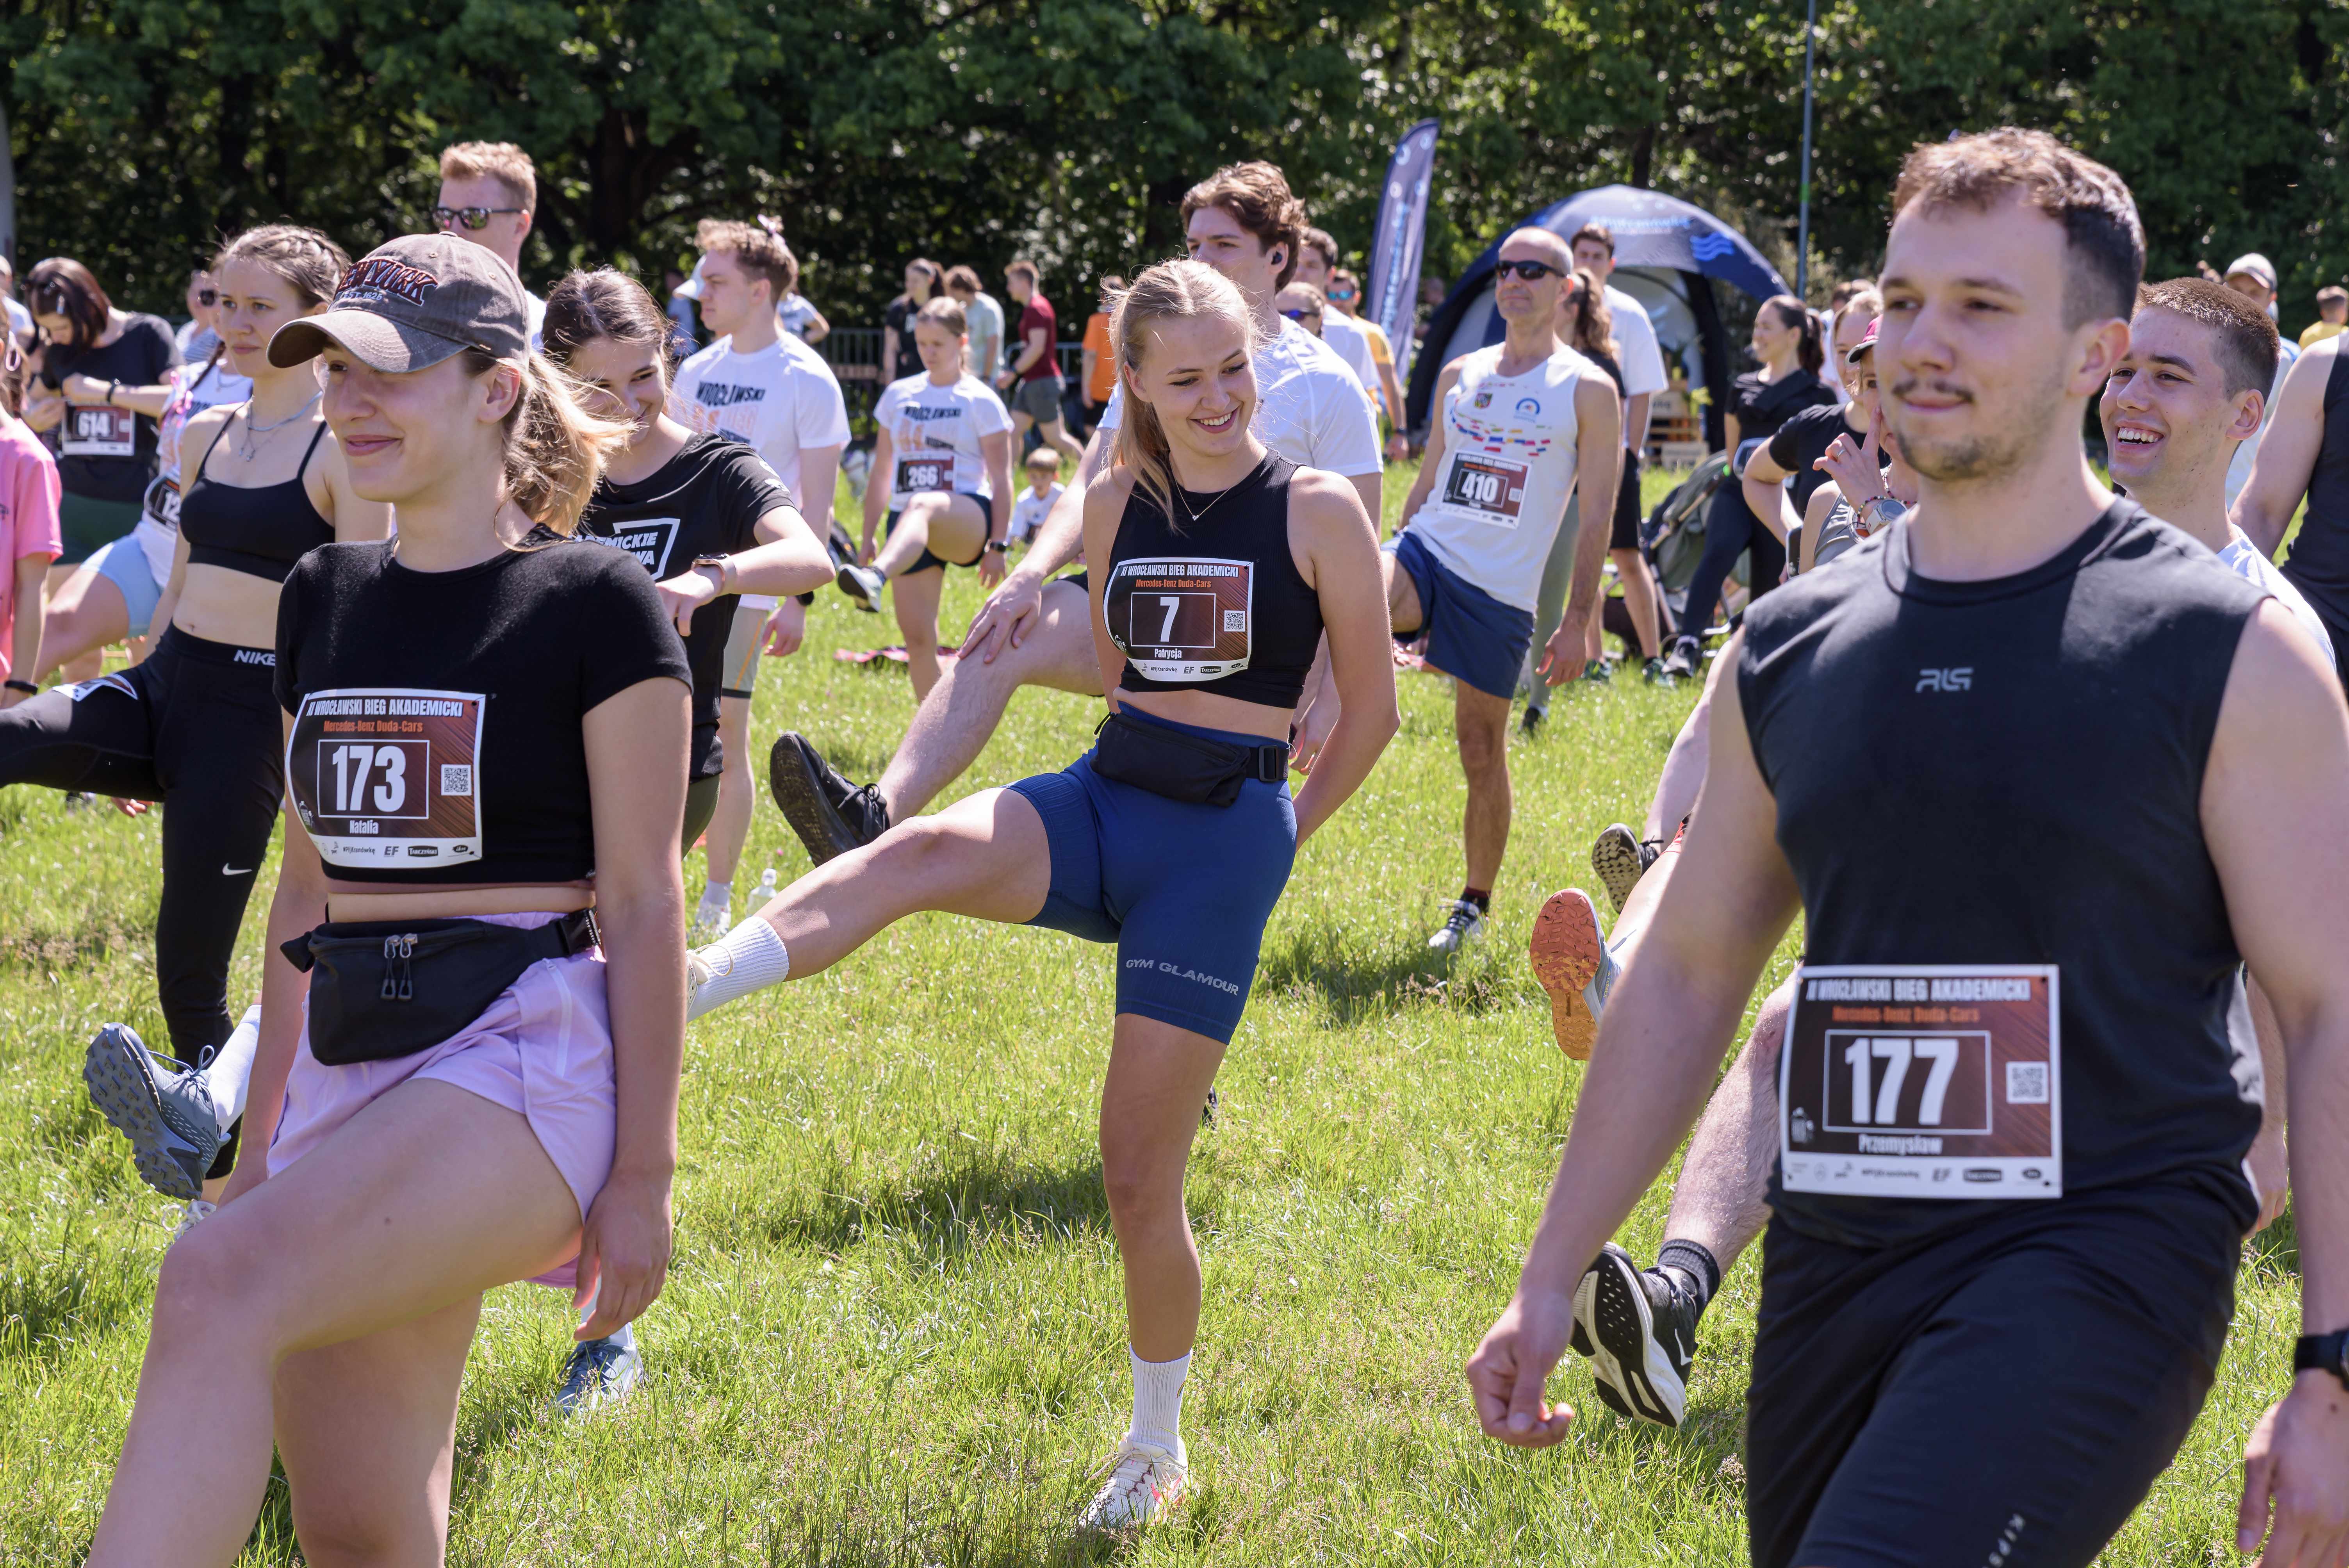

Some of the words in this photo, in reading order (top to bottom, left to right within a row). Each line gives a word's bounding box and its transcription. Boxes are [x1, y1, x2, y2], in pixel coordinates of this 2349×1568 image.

[363, 259, 438, 307] YORK
[78, 412, 110, 437] 614
[908, 465, 938, 487] 266
[1461, 471, 1499, 503] 410
[162, 490, 181, 519] 12
[1121, 566, 1128, 576] XI
[1128, 565, 1167, 576] WROCŁAWSKI
[1169, 565, 1185, 576] BIEG
[1187, 565, 1239, 577] AKADEMICKI
[1136, 579, 1176, 587] Mercedes-Benz
[1178, 579, 1211, 588] Duda-Cars
[1160, 597, 1180, 642] 7
[234, 649, 275, 666] NIKE
[1154, 648, 1182, 659] Patrycja
[314, 699, 362, 715] WROCŁAWSKI
[364, 699, 387, 715] BIEG
[389, 699, 463, 717] AKADEMICKI
[324, 720, 375, 732] Mercedes-Benz
[376, 720, 423, 732] Duda-Cars
[332, 745, 406, 813] 173
[349, 820, 379, 834] Natalia
[384, 845, 399, 855] EF
[1126, 959, 1155, 969] GYM
[1158, 962, 1239, 996] GLAMOUR
[1893, 978, 1929, 1002] BIEG
[1930, 978, 2031, 1002] AKADEMICKI
[1845, 1038, 1960, 1126] 177
[1858, 1133, 1943, 1156] Przemysław
